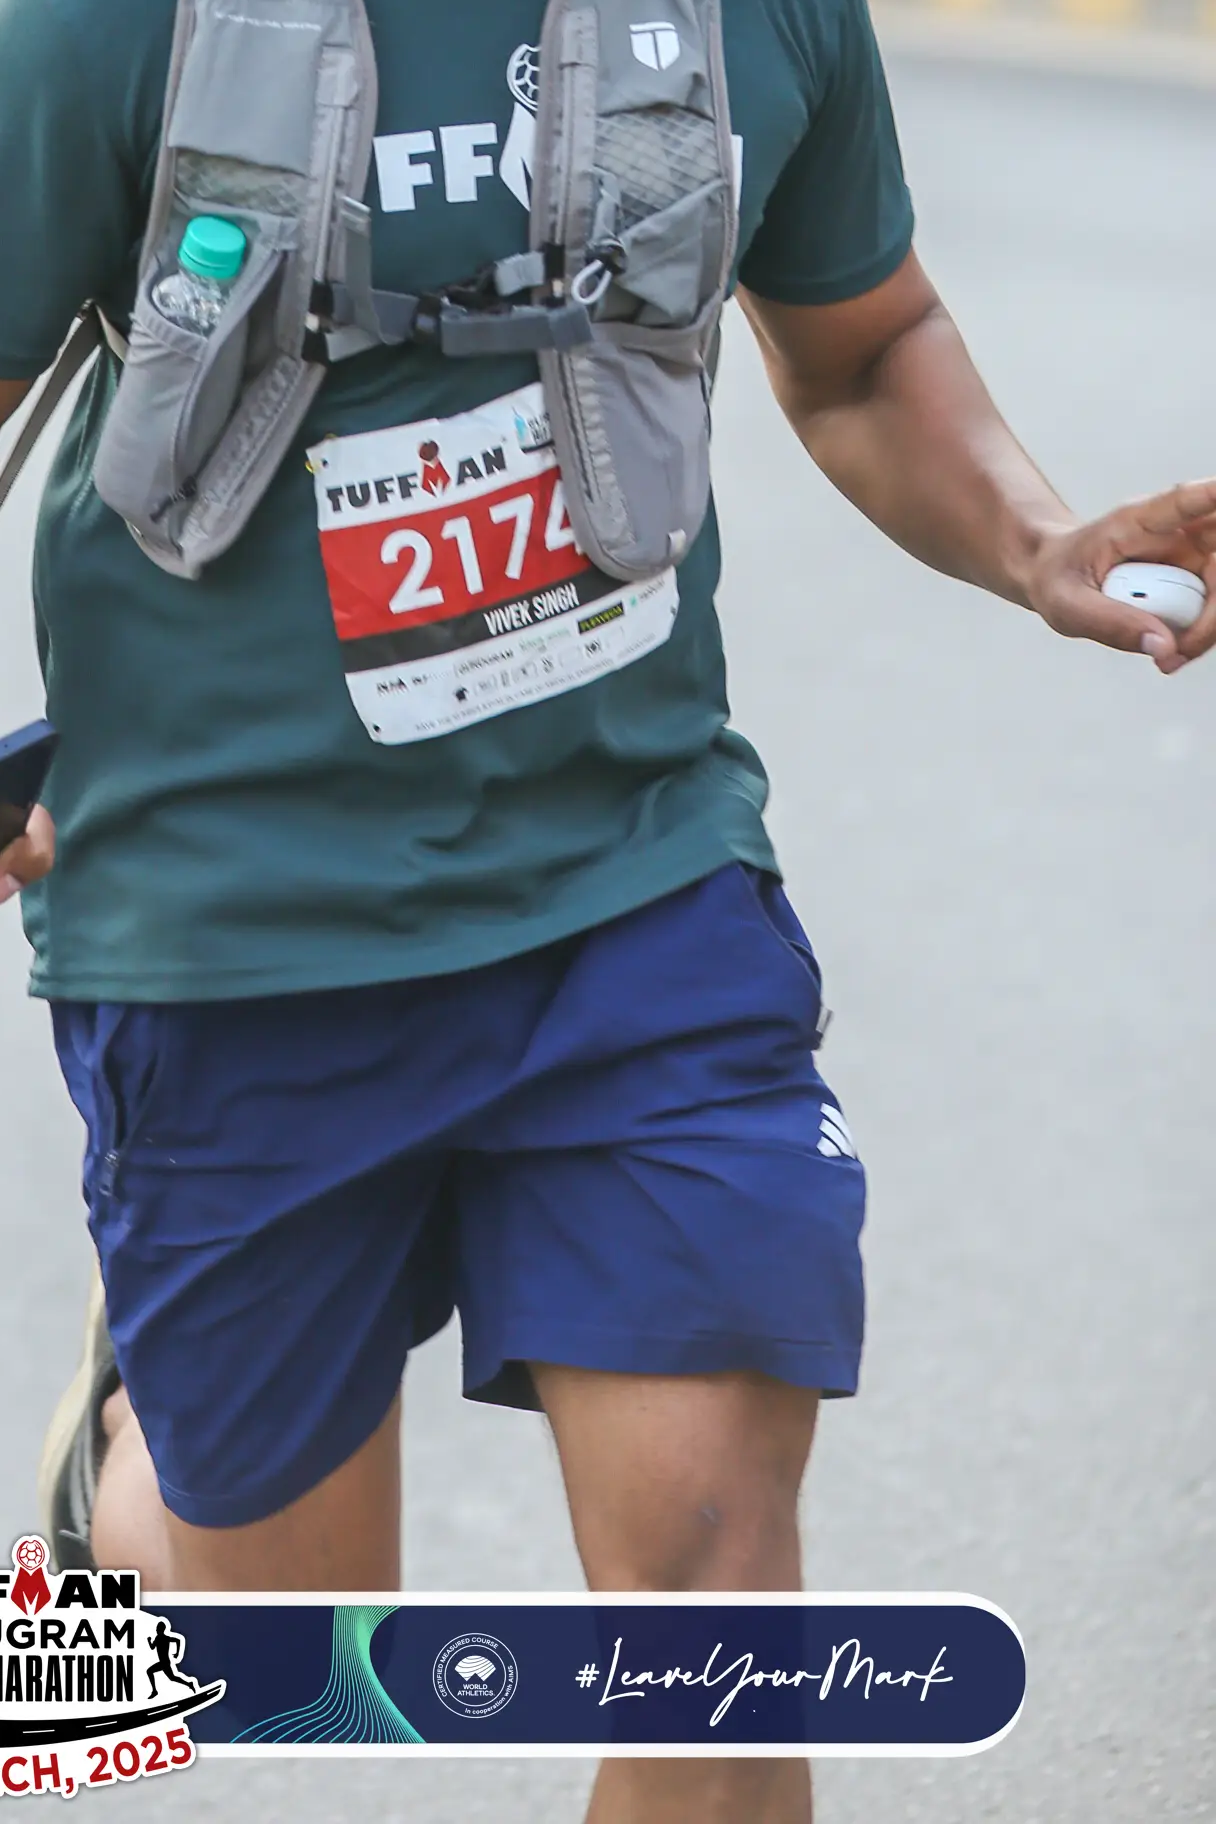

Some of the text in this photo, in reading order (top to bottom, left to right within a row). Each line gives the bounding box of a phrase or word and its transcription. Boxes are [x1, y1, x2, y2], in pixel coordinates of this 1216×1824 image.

[325, 440, 508, 513] TUFFMAN
[483, 600, 534, 636] VIVEK
[532, 582, 580, 621] SINGH
